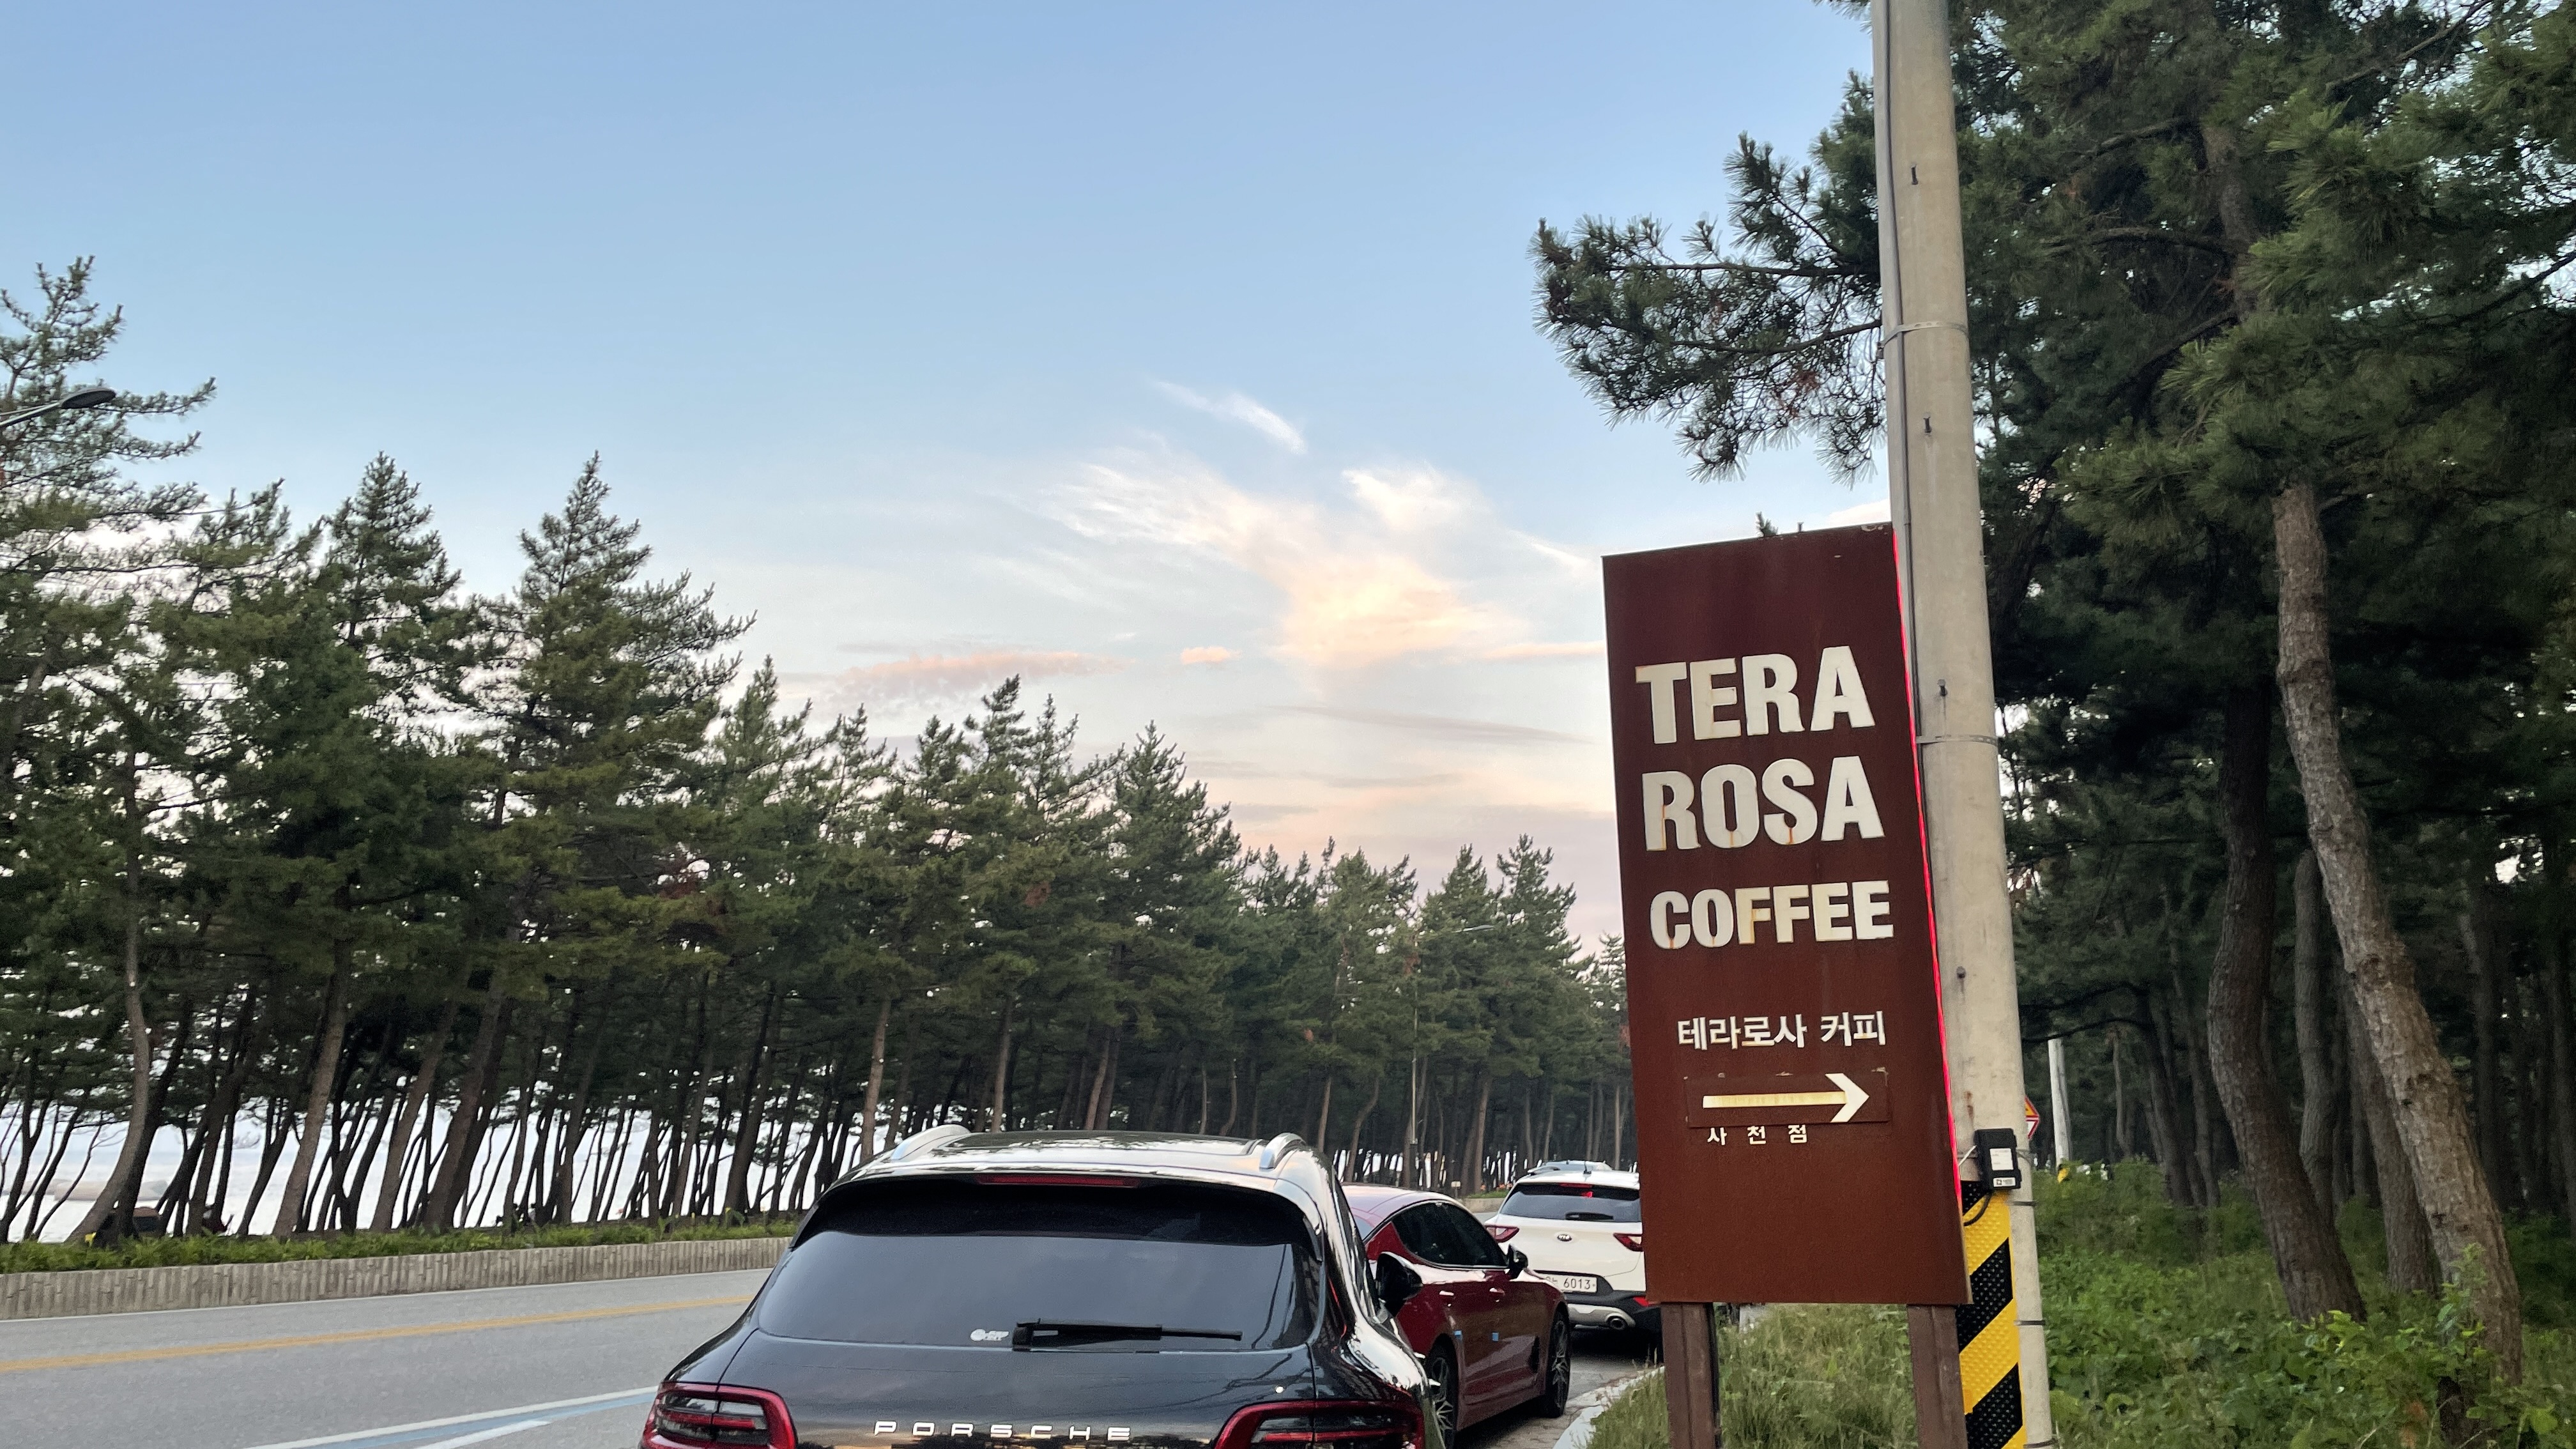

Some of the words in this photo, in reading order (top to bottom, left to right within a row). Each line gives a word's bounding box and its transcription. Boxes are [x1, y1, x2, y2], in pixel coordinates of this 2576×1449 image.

[1636, 645, 1876, 744] TERA
[1642, 755, 1885, 851] ROSA
[1650, 880, 1894, 949] COFFEE
[1677, 1013, 1807, 1050] 테라로사
[1820, 1011, 1886, 1046] 커피
[873, 1420, 1131, 1441] PORSCHE
